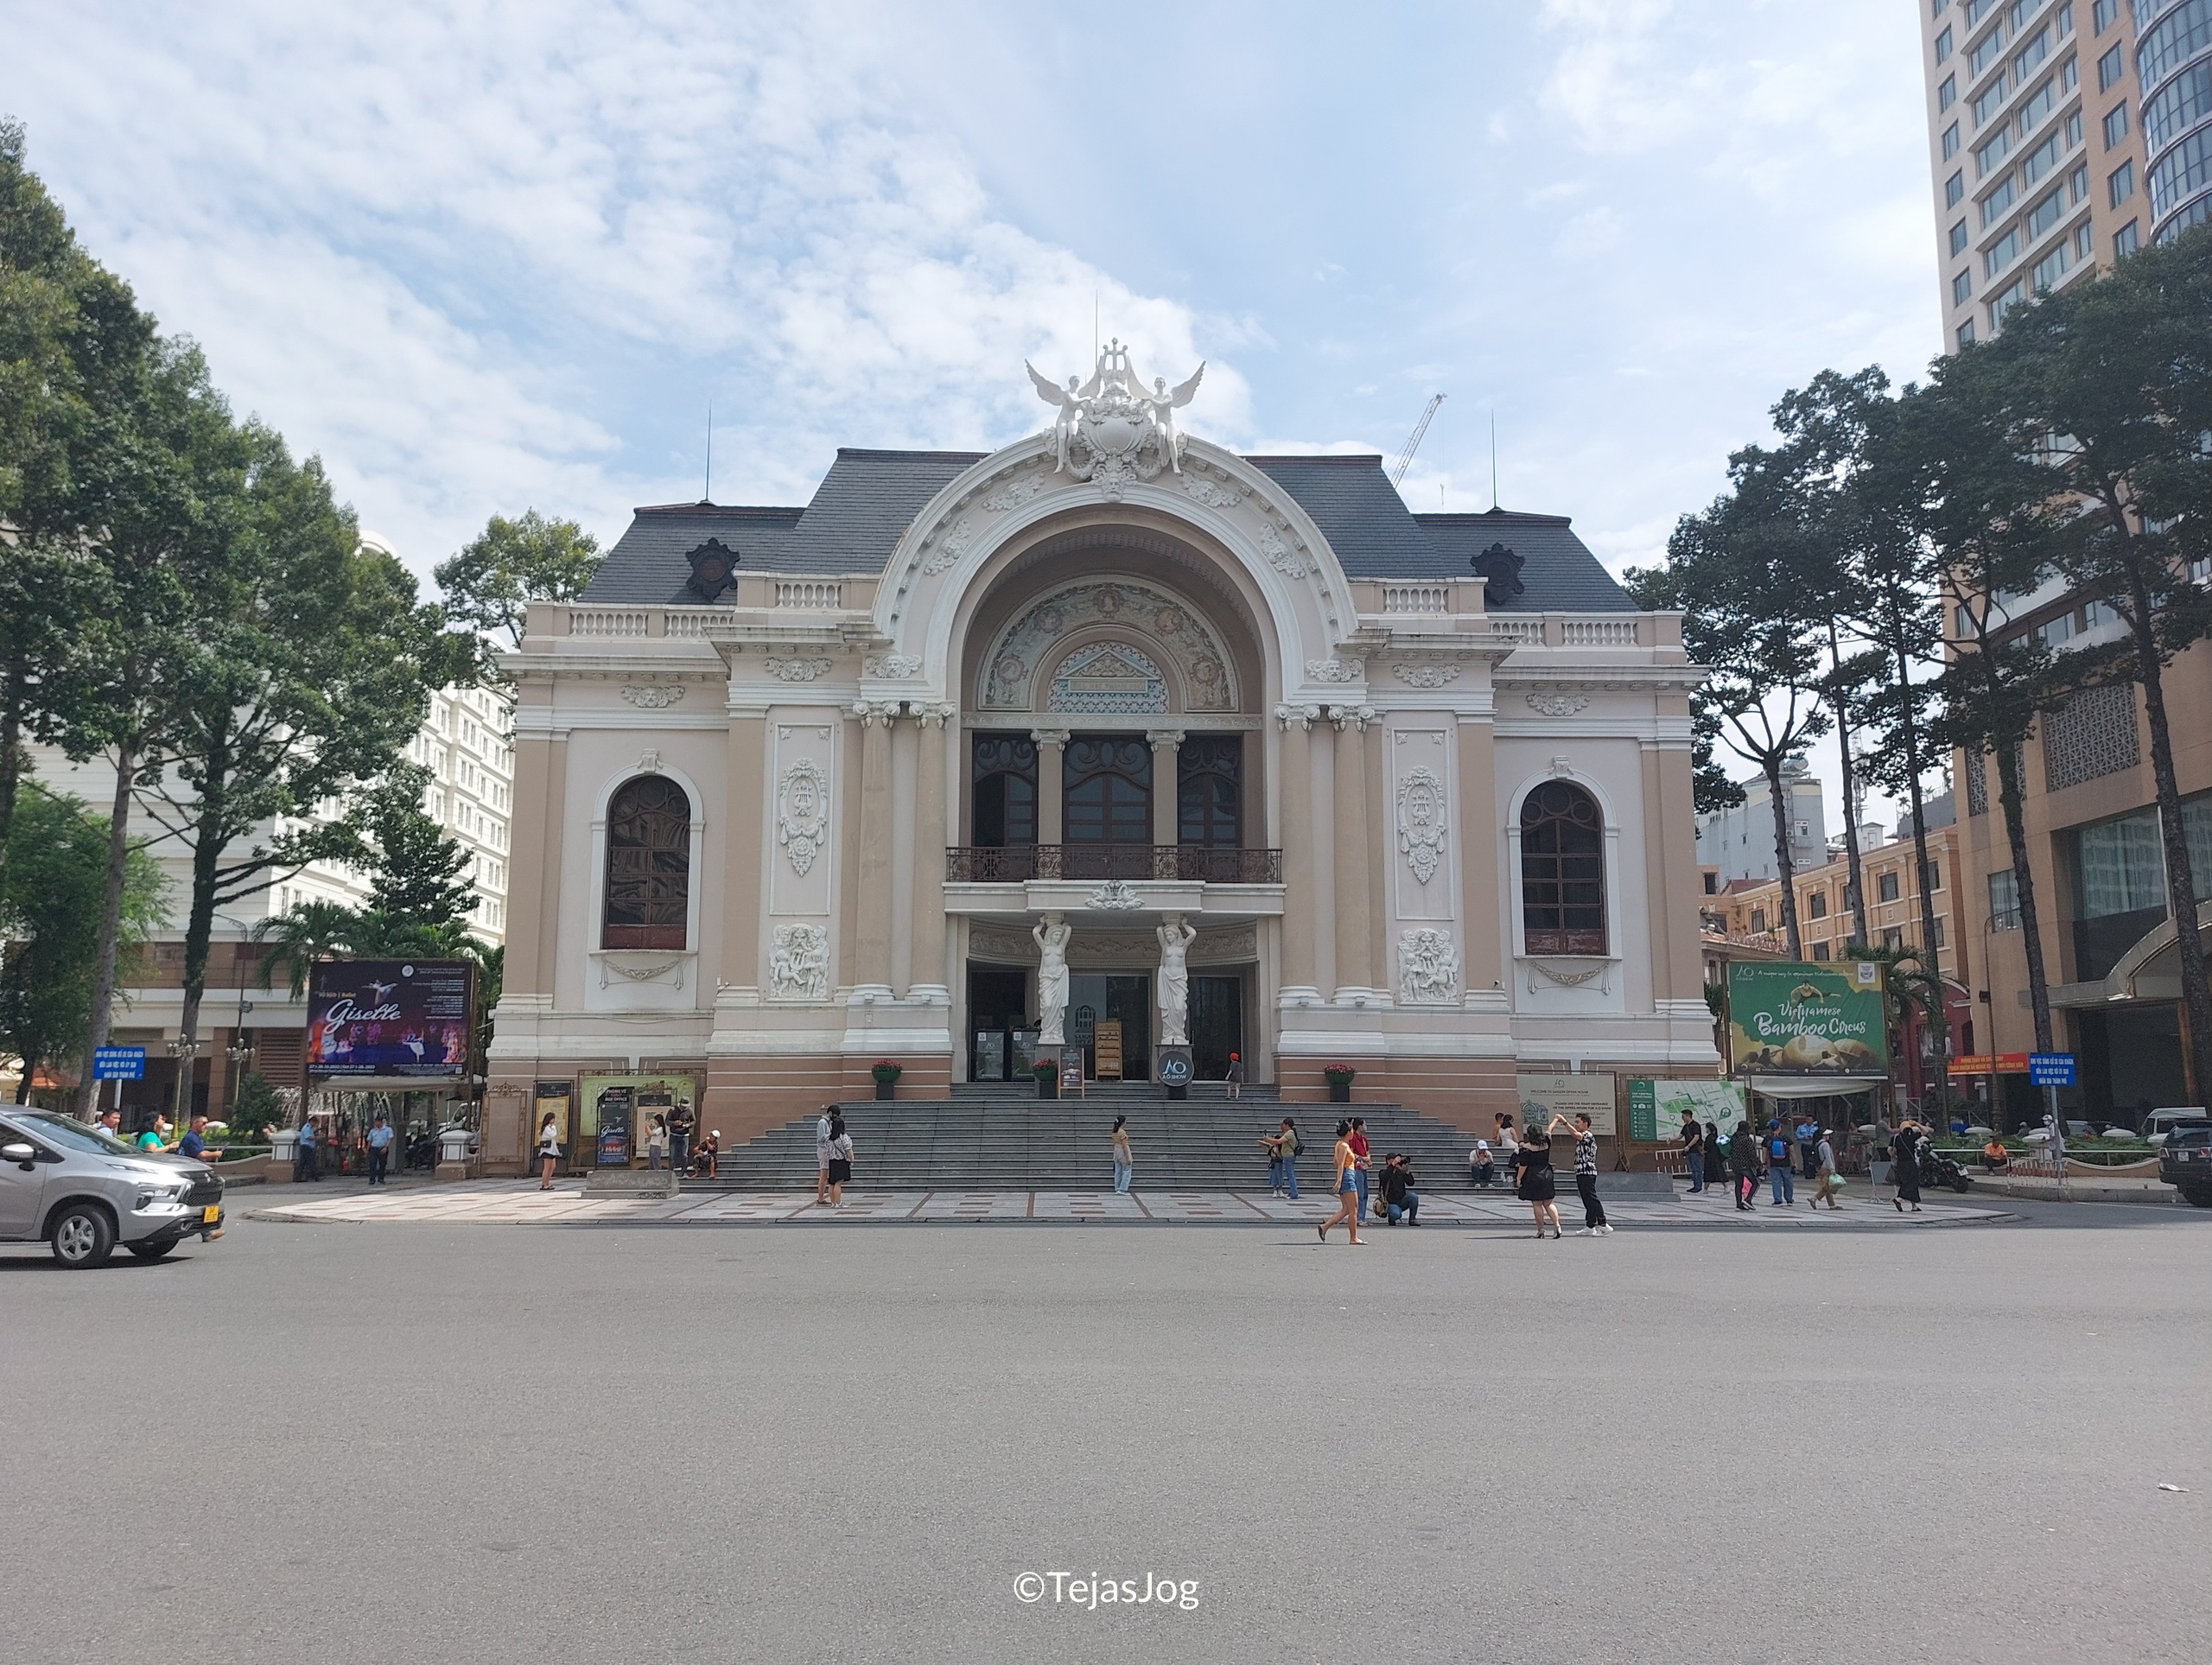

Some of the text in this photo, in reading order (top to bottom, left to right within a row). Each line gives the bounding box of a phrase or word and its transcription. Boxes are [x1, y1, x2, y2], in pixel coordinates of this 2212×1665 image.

[324, 999, 402, 1035] Giselle
[1777, 1000, 1841, 1020] Vietnamese
[1753, 1012, 1866, 1036] Bamboo Circus
